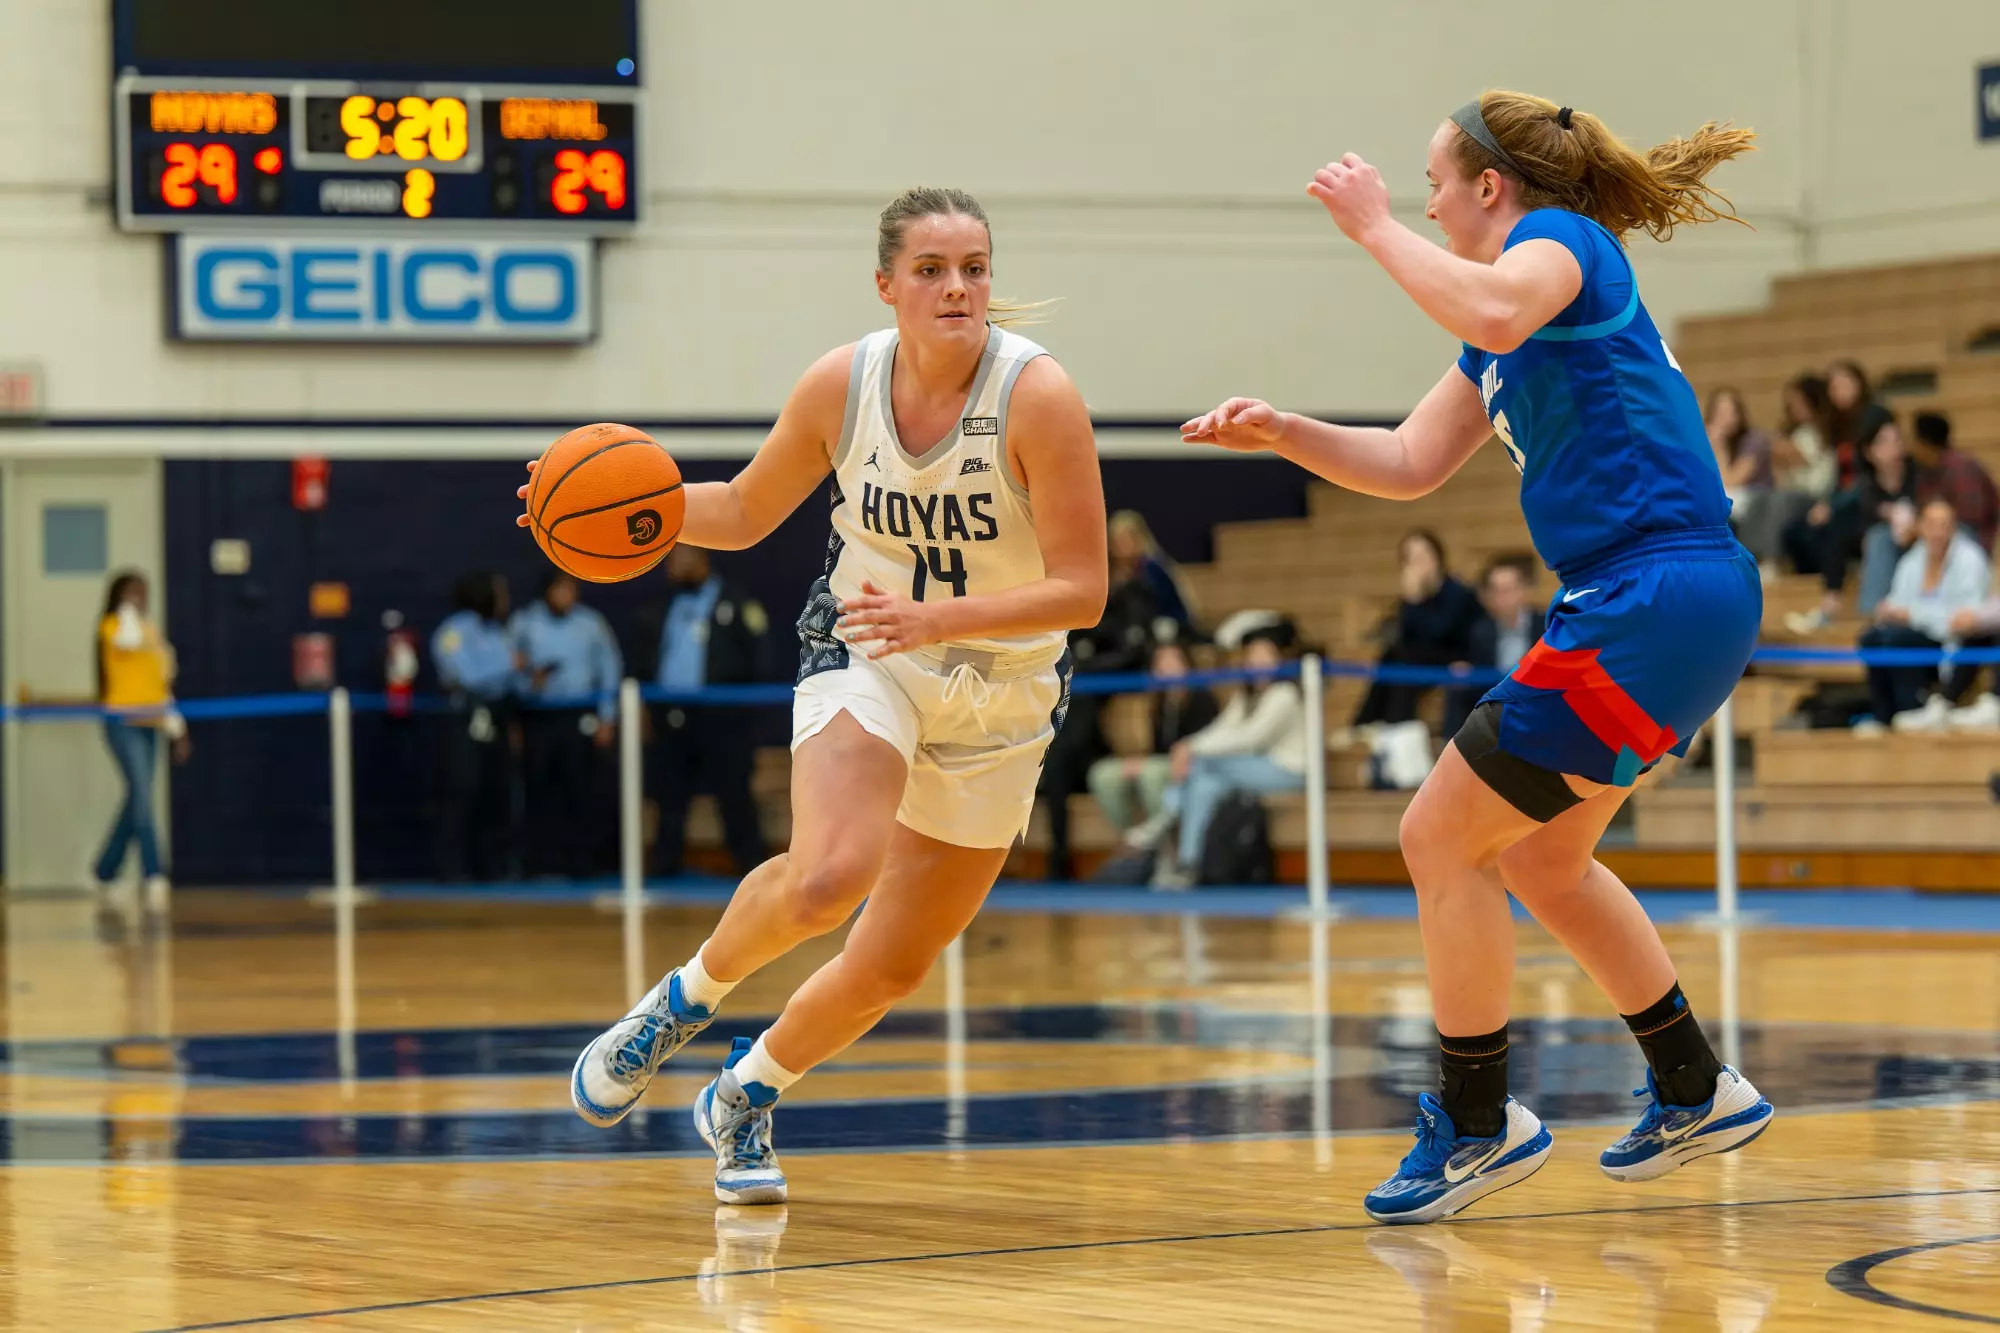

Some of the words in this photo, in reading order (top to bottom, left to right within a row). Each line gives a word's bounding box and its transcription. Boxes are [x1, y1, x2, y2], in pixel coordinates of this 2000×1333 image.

[340, 95, 468, 161] 5:20
[161, 142, 237, 208] 29
[551, 148, 626, 214] 29
[194, 246, 577, 324] GEICO
[964, 427, 997, 435] CHANGE
[961, 463, 990, 473] EAST
[963, 457, 982, 466] BIG
[862, 482, 999, 542] HOYAS
[906, 544, 967, 603] 14
